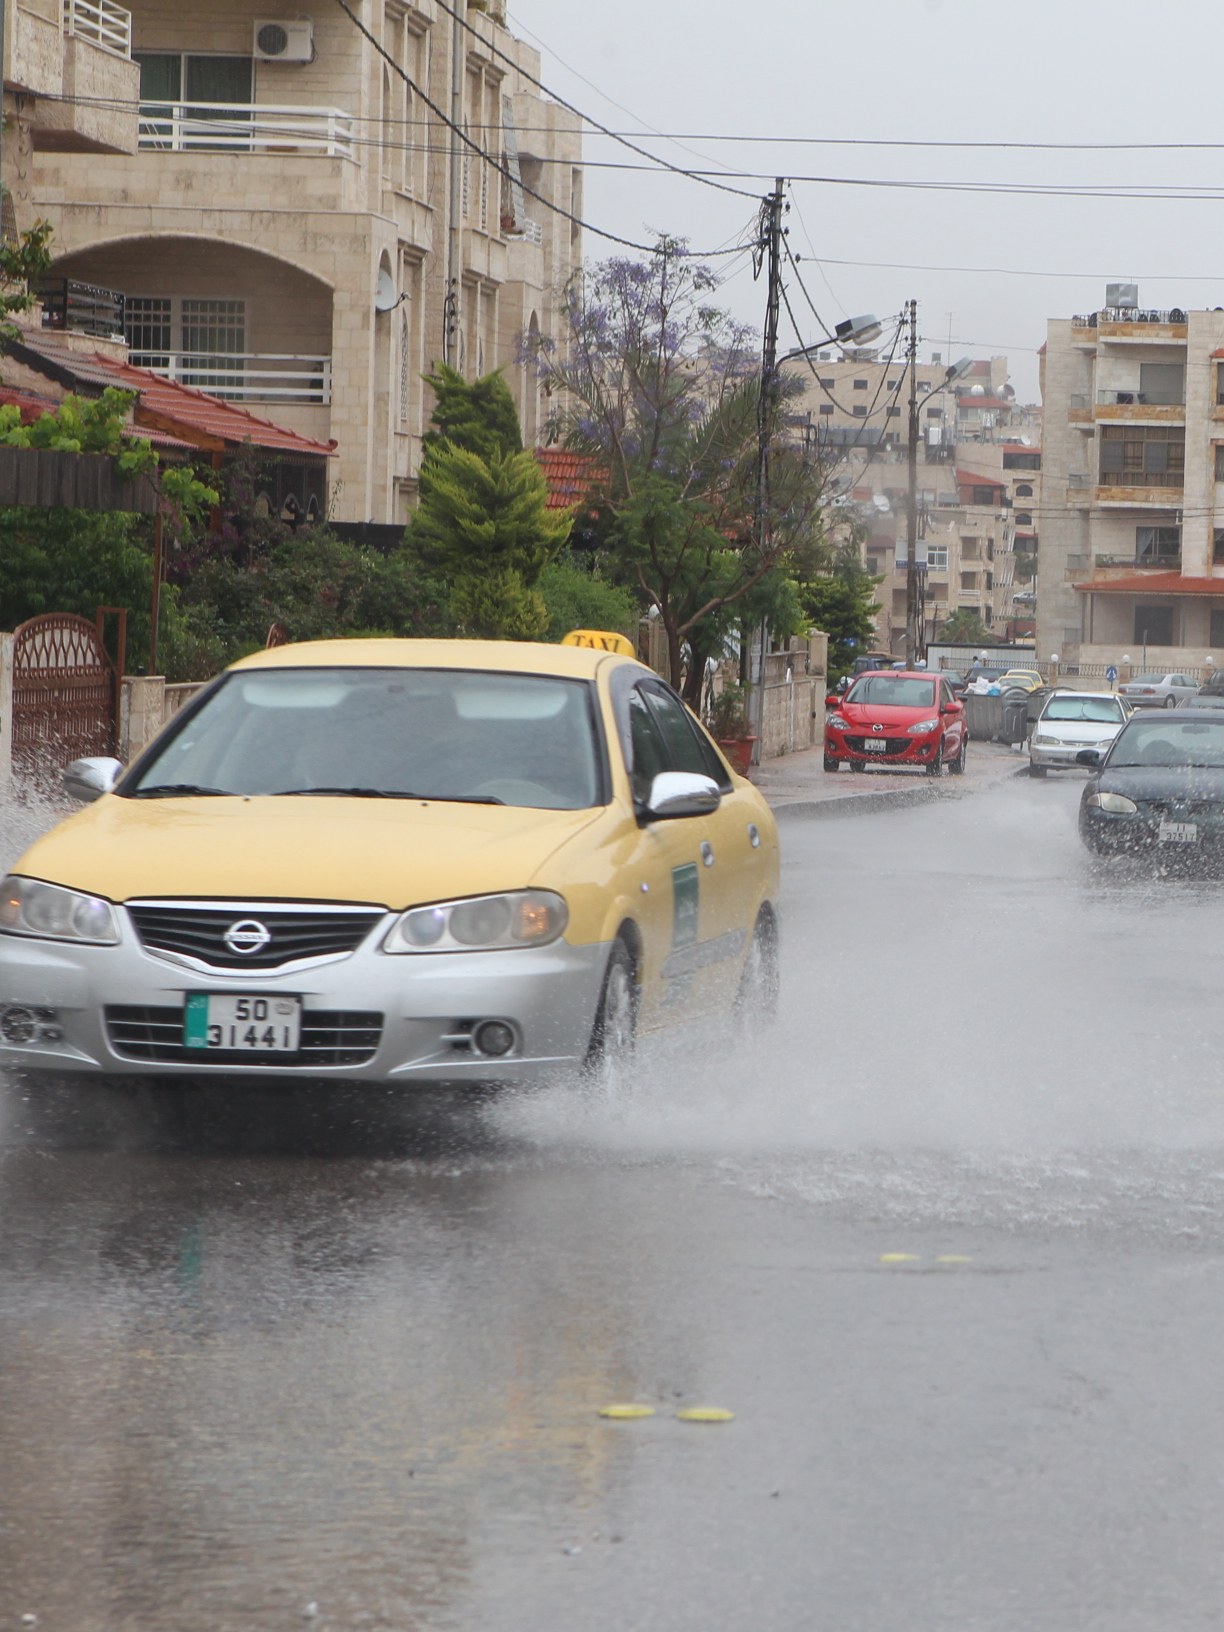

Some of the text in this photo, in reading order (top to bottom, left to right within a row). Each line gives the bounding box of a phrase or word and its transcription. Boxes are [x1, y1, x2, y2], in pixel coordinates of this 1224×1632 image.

[573, 634, 620, 654] TAXI
[1166, 832, 1195, 841] 37517
[235, 998, 268, 1021] 50
[208, 1024, 290, 1048] 31441
